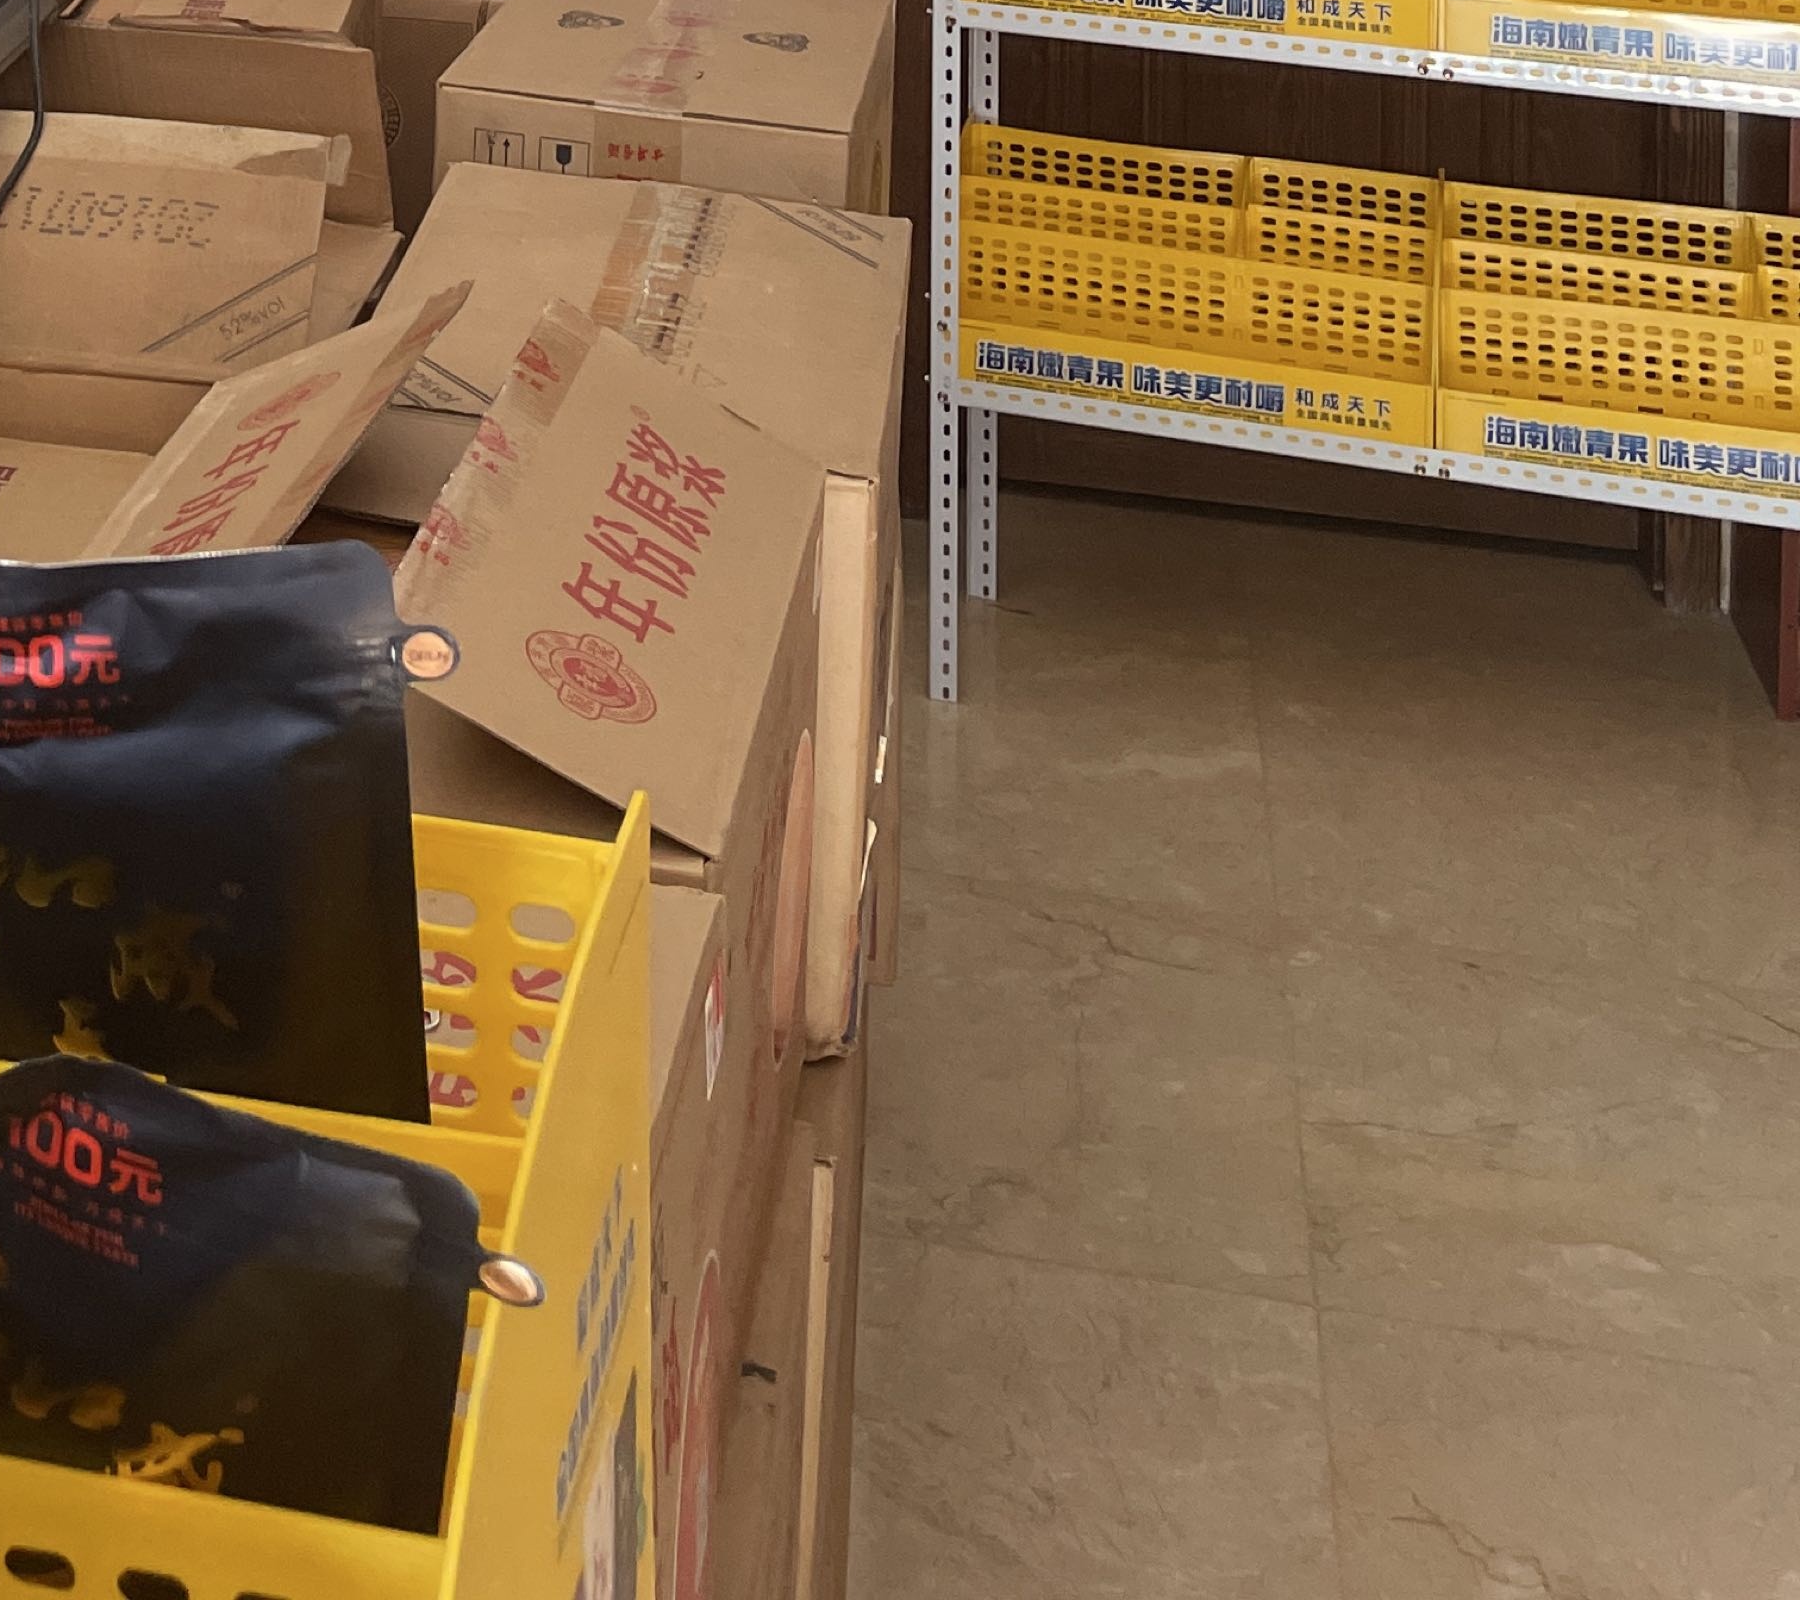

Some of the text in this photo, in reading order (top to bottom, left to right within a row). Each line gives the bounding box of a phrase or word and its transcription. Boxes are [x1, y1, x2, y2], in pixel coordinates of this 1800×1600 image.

[1492, 15, 1654, 59] 海南嫩青果
[976, 341, 1285, 413] 海南嫩青果 味美更耐嚼
[1294, 386, 1392, 415] 和成天下
[1486, 415, 1800, 484] 海南嫩青果 味美更耐
[561, 421, 727, 643] 年份原浆
[8, 1109, 164, 1205] 100元
